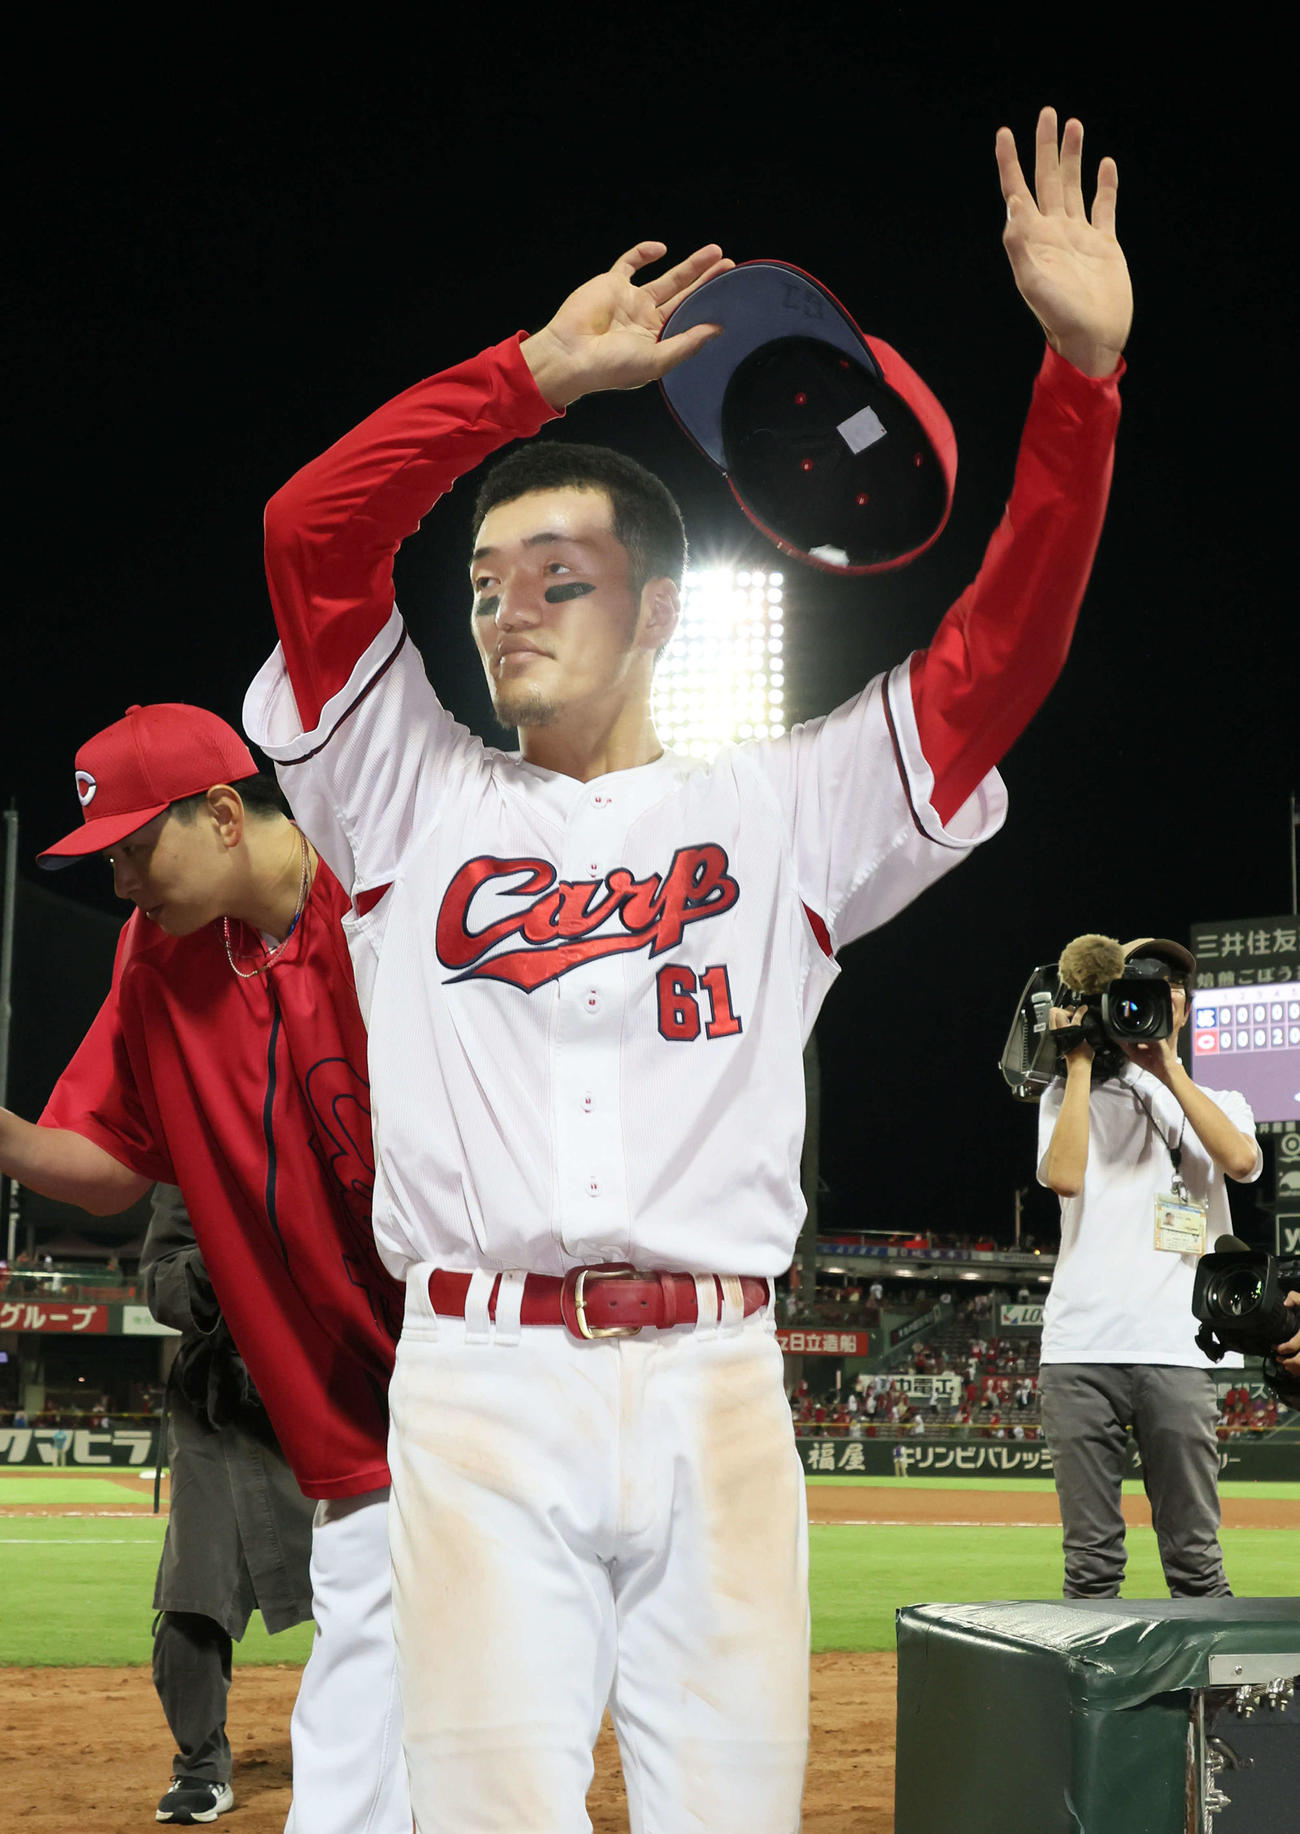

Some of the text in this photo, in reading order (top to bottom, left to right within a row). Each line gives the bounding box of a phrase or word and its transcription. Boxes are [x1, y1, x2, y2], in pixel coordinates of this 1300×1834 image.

[436, 842, 740, 972] Carp
[1196, 928, 1300, 958] 三井住友
[656, 962, 743, 1041] 61
[1220, 1008, 1231, 1025] 0
[1237, 1006, 1249, 1023] 0
[1254, 1005, 1266, 1022] 0
[1271, 1004, 1283, 1021] 0
[1289, 1002, 1300, 1020] 0
[1220, 1032, 1232, 1049] 0
[1237, 1030, 1249, 1047] 0
[1254, 1029, 1266, 1046] 0
[1272, 1028, 1283, 1045] 2
[1289, 1026, 1300, 1044] 0
[0, 1303, 97, 1331] グループ
[1021, 1308, 1043, 1323] LO
[807, 1442, 866, 1471] 福屋
